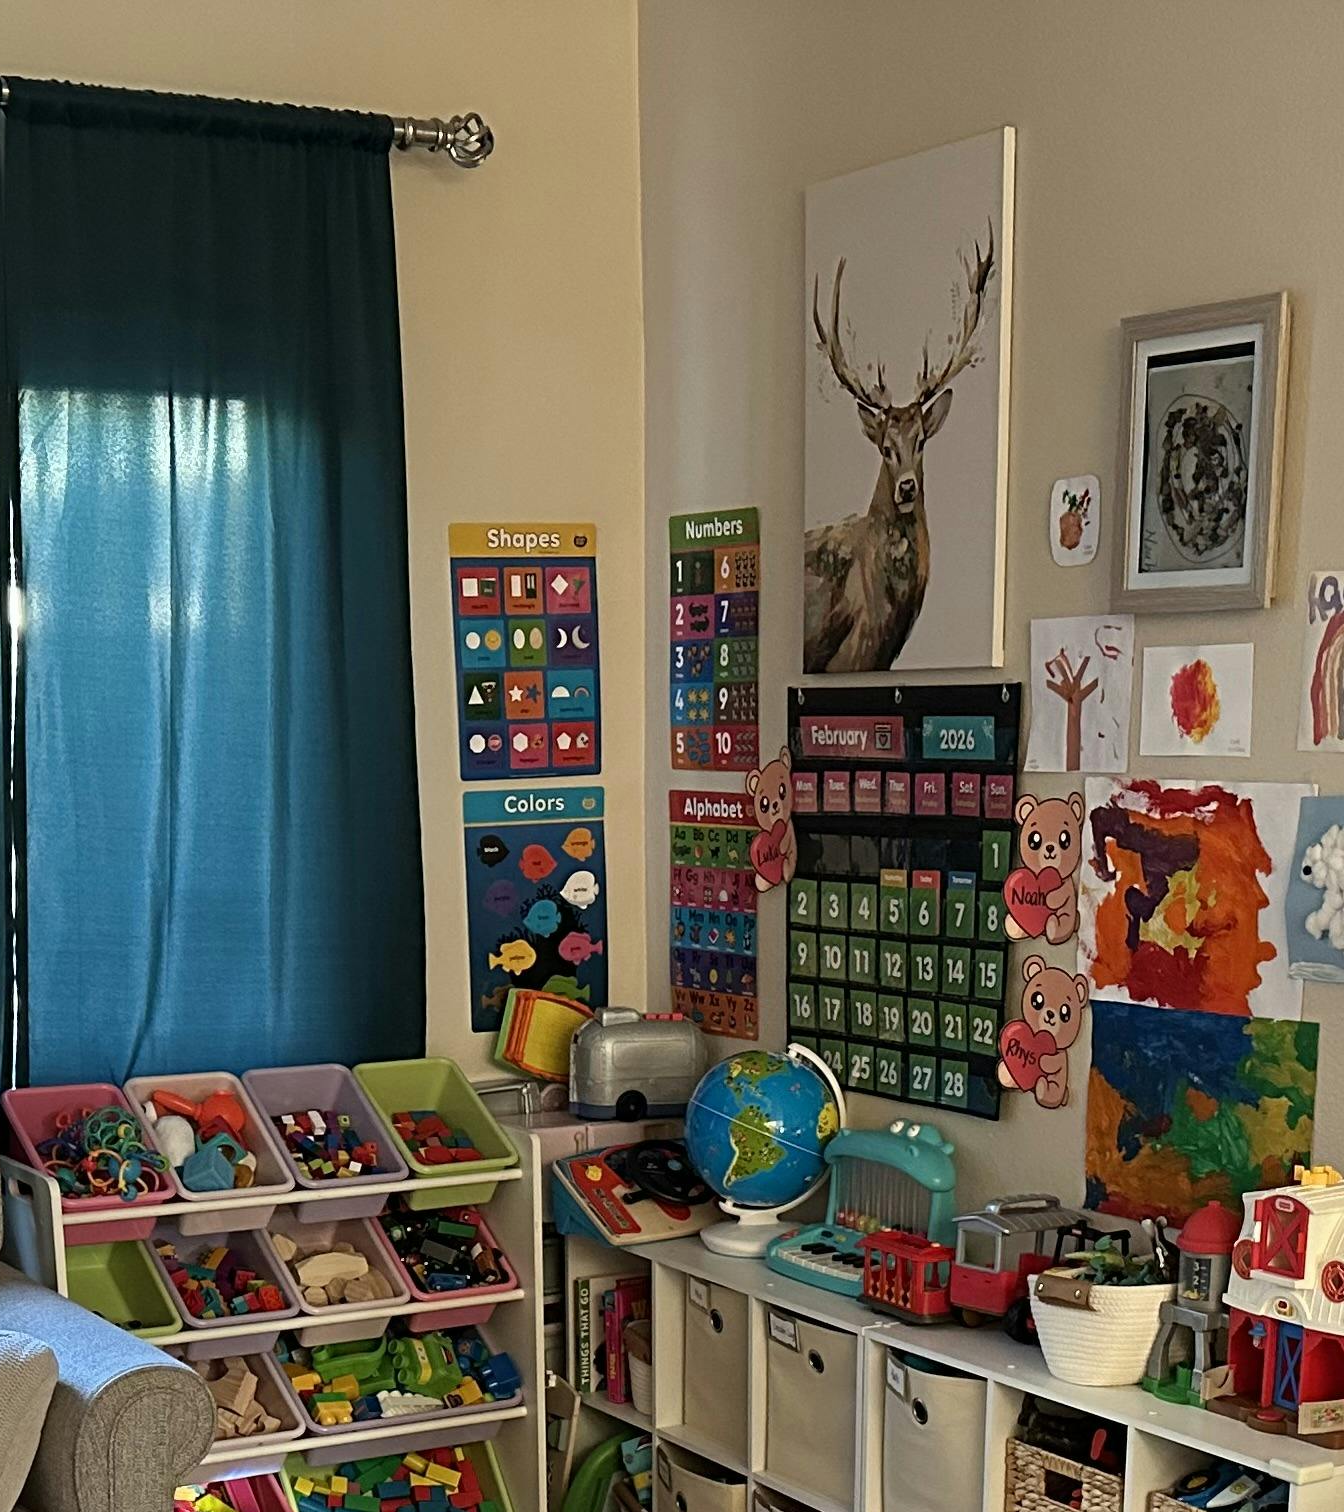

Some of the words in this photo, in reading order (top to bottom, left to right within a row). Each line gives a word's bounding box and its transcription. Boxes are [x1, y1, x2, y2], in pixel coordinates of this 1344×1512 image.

[487, 528, 561, 553] Shapes
[685, 517, 744, 539] Numbers
[676, 560, 683, 582] 1
[720, 556, 730, 579] 6
[675, 603, 684, 625] 2
[720, 600, 729, 623] 7
[675, 646, 684, 668] 3
[719, 644, 729, 666] 8
[674, 689, 684, 710] 4
[718, 687, 728, 710] 9
[676, 732, 685, 754] 5
[715, 731, 732, 755] 10
[811, 724, 868, 751] February
[939, 728, 975, 750] 2026
[504, 793, 565, 813] Colors
[684, 797, 744, 821] Alphabet
[992, 842, 999, 869] 1
[1011, 886, 1046, 906] Noah
[797, 891, 808, 916] 2
[828, 894, 840, 918] 3
[858, 897, 871, 920] 4
[888, 899, 900, 924] 5
[918, 900, 930, 926] 6
[954, 902, 966, 928] 7
[987, 905, 999, 932] 8
[797, 942, 808, 966] 9
[824, 945, 842, 970] 10
[854, 949, 870, 974] 11
[885, 951, 902, 978] 12
[916, 956, 934, 981] 13
[947, 958, 965, 984] 14
[979, 962, 997, 988] 15
[794, 993, 811, 1018] 16
[824, 997, 840, 1021] 17
[856, 1001, 873, 1026] 18
[883, 1006, 899, 1031] 19
[911, 1010, 932, 1036] 20
[944, 1014, 962, 1040] 21
[973, 1017, 994, 1045] 22
[824, 1051, 843, 1075] 24
[851, 1055, 870, 1080] 25
[879, 1059, 897, 1085] 26
[912, 1065, 932, 1091] 27
[944, 1071, 964, 1097] 28
[1192, 1261, 1200, 1272] 3
[1192, 1275, 1199, 1286] 2
[580, 1288, 589, 1305] GO
[580, 1309, 590, 1339] THAT
[580, 1342, 590, 1385] THINGS
